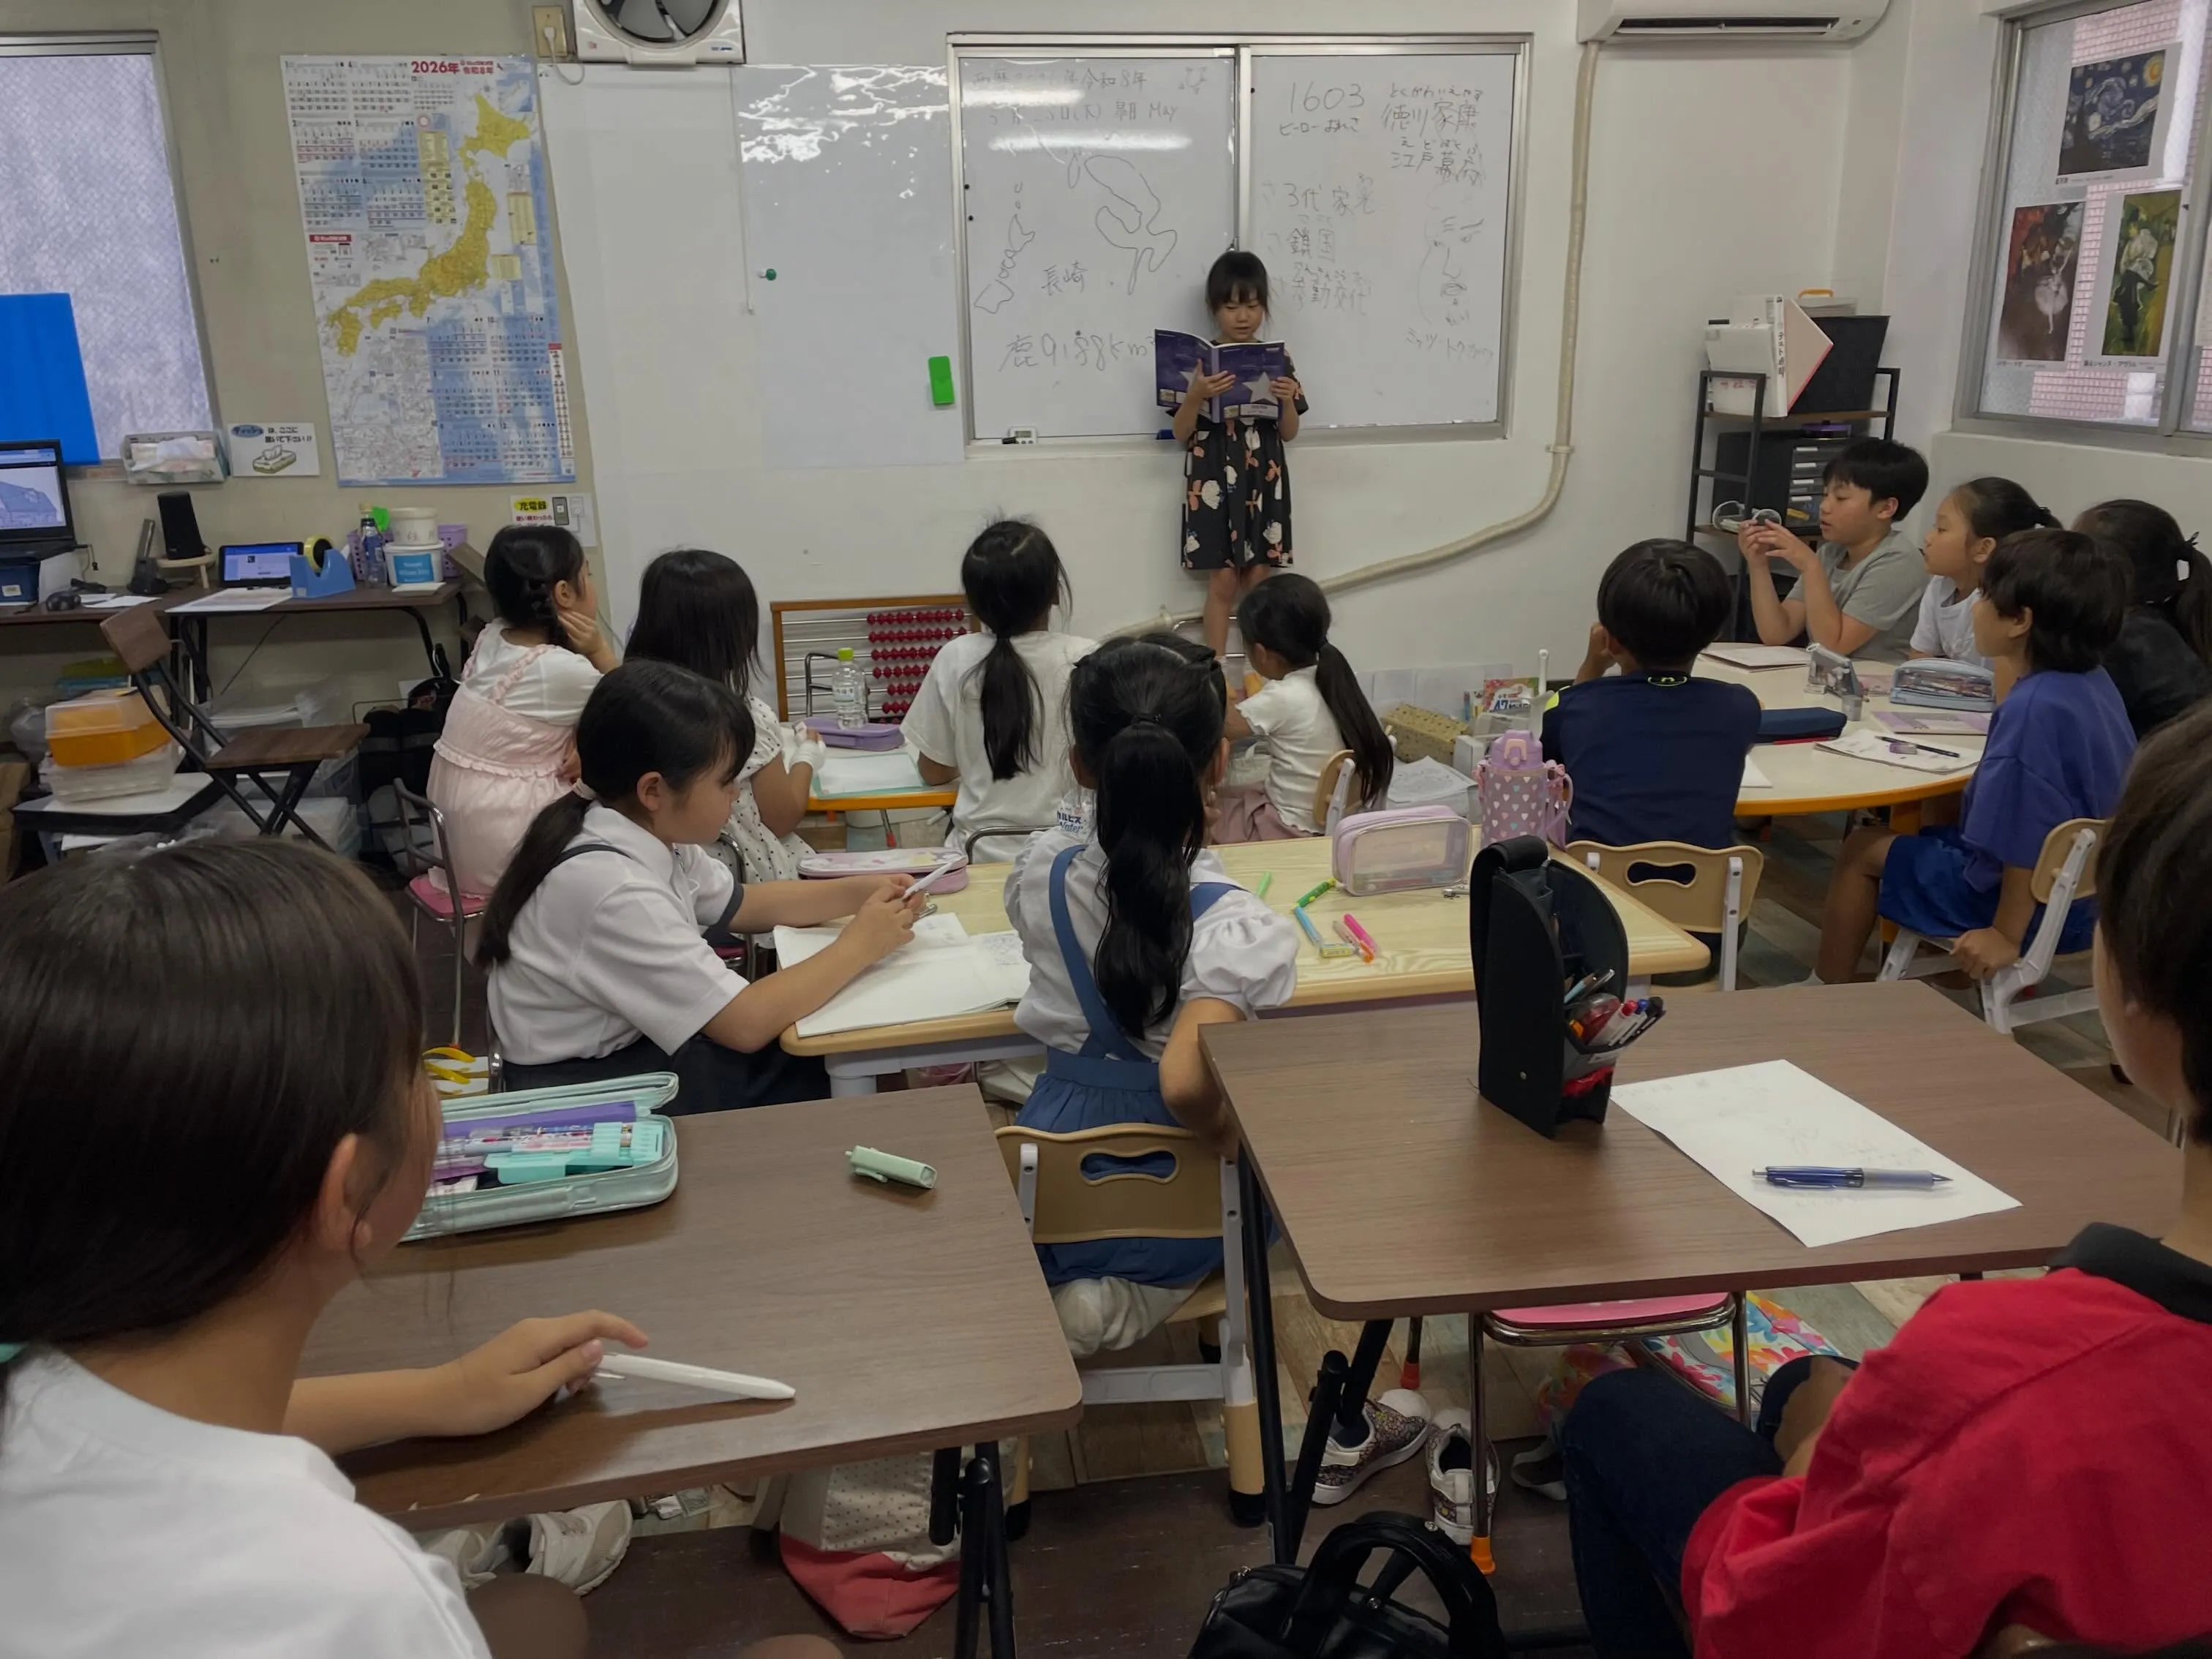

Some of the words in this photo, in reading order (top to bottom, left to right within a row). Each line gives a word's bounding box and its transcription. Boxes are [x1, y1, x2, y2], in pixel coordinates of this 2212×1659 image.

[411, 61, 459, 75] 2026年
[1290, 82, 1366, 113] 1603
[1149, 101, 1179, 123] May
[1382, 99, 1481, 137] 徳川家康
[1042, 260, 1088, 296] 長崎
[520, 501, 547, 511] 充電器
